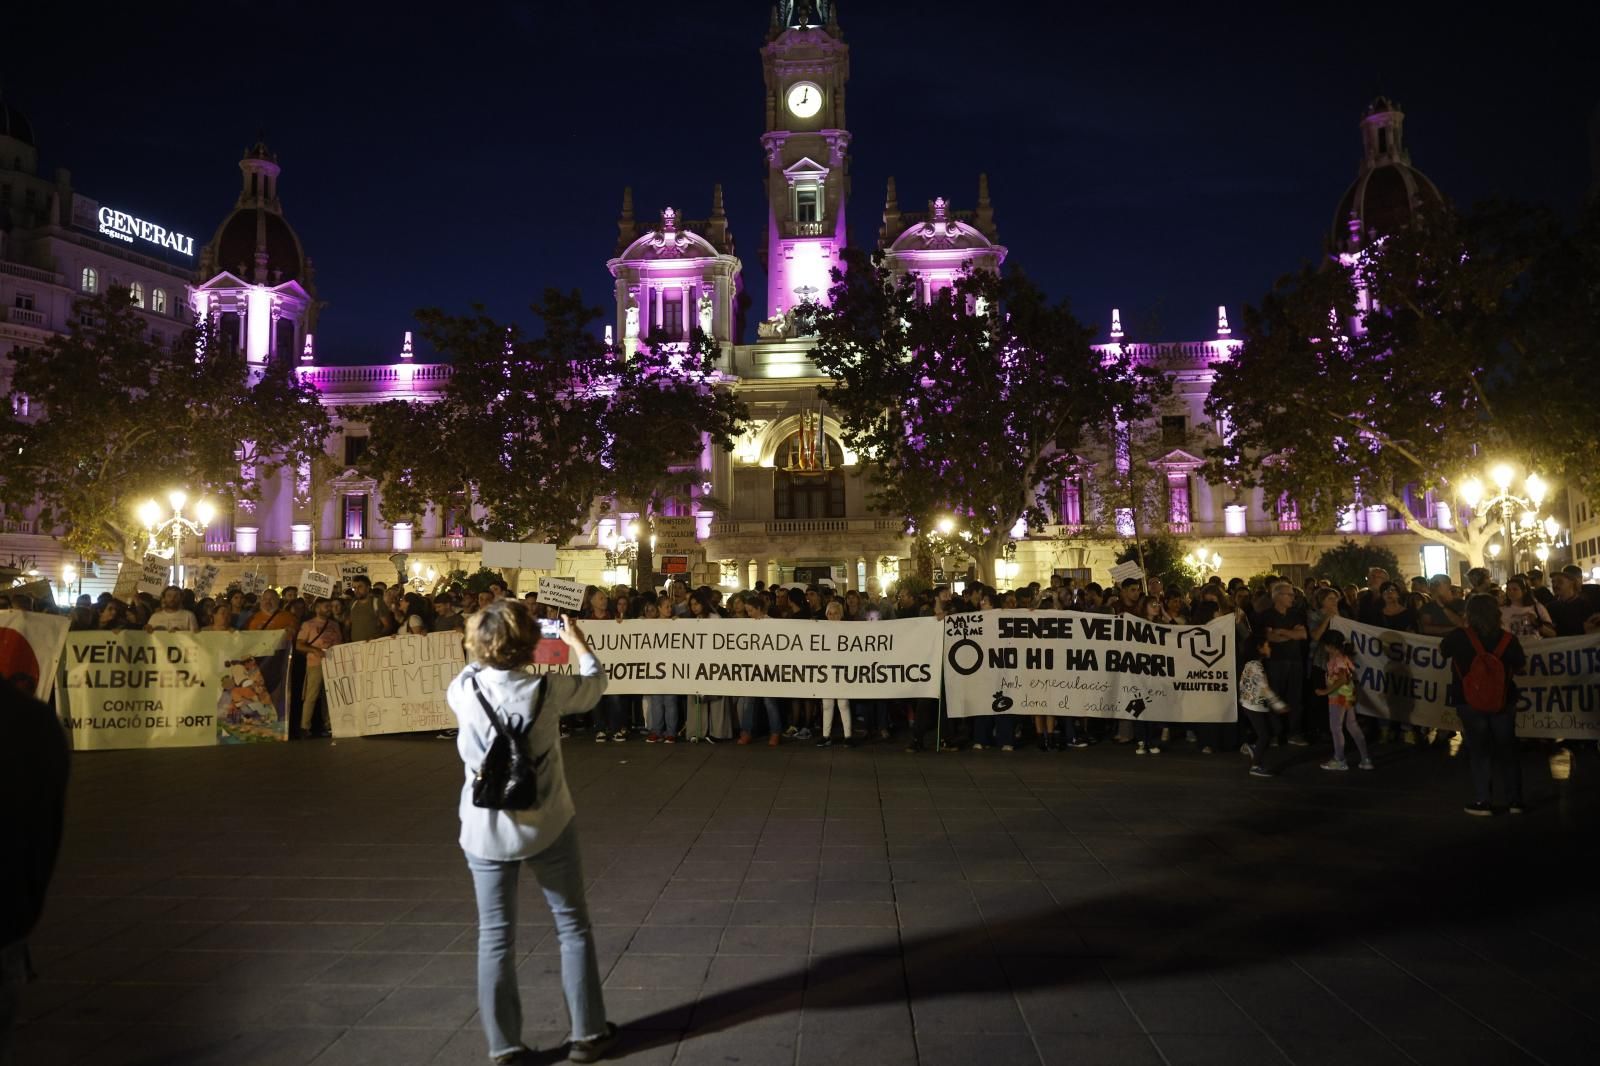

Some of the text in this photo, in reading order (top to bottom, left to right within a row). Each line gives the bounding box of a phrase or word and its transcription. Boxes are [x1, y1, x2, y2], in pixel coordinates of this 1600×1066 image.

[98, 206, 194, 256] GENERALI
[99, 224, 134, 243] Seguros
[553, 583, 576, 592] VIVIENDA
[946, 614, 984, 624] AMICS
[953, 621, 969, 629] DEL
[946, 627, 984, 639] CARME
[998, 614, 1172, 646] SENSE VEÏNAT
[439, 632, 463, 660] DRE
[586, 633, 893, 652] AJUNTAMENT DEGRADA EL BARRI
[1351, 631, 1383, 657] NO
[1387, 641, 1447, 669] SIGU
[73, 641, 157, 664] VEÏNAT
[988, 647, 1175, 678] NO HI HA BARRI
[403, 660, 464, 697] MERCA
[602, 662, 667, 681] HOTELS
[672, 663, 690, 680] NI
[694, 662, 828, 684] APARTAMENTS
[831, 661, 932, 684] TURÍSTICS
[1216, 671, 1229, 680] DE
[1353, 661, 1438, 703] ANVIEU
[1029, 675, 1111, 692] especulació
[1122, 684, 1140, 694] no
[1173, 682, 1229, 692] VELLUTERS
[103, 700, 164, 712] CONTRA
[1021, 695, 1121, 713] dona el salari
[145, 717, 171, 728] DEL
[175, 715, 214, 728] PORT
